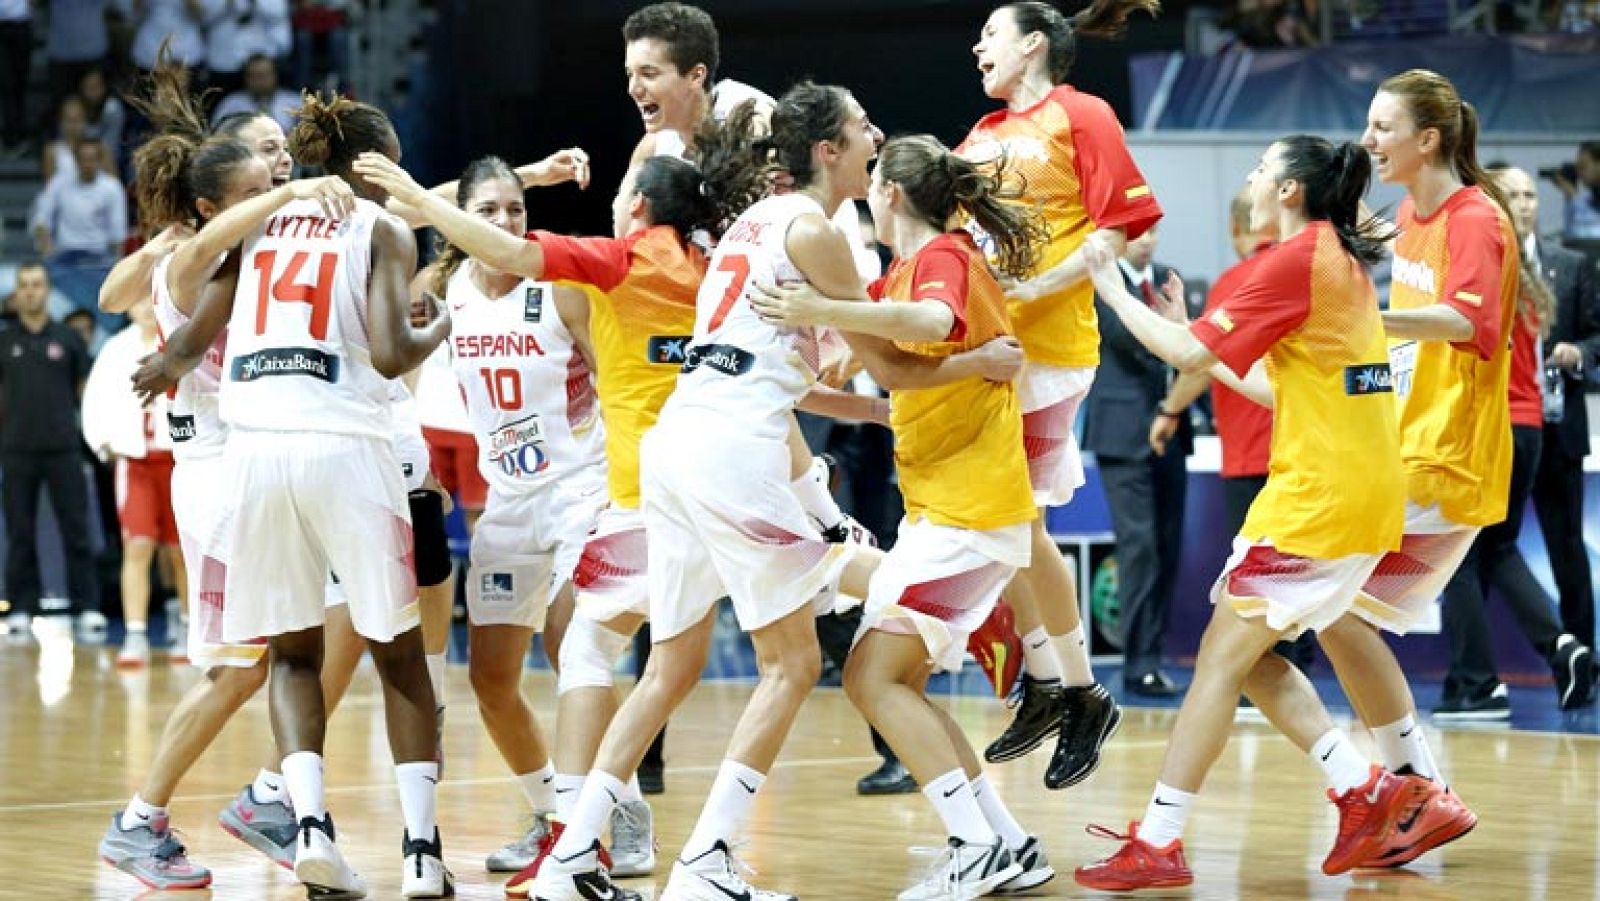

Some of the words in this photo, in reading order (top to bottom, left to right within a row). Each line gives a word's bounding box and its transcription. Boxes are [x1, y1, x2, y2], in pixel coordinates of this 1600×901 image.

[265, 215, 341, 239] LYTTLE
[253, 250, 338, 342] 14
[707, 254, 750, 334] 7
[455, 331, 545, 358] ESPAÑA
[257, 354, 328, 376] CaixaBank
[479, 366, 524, 411] 10
